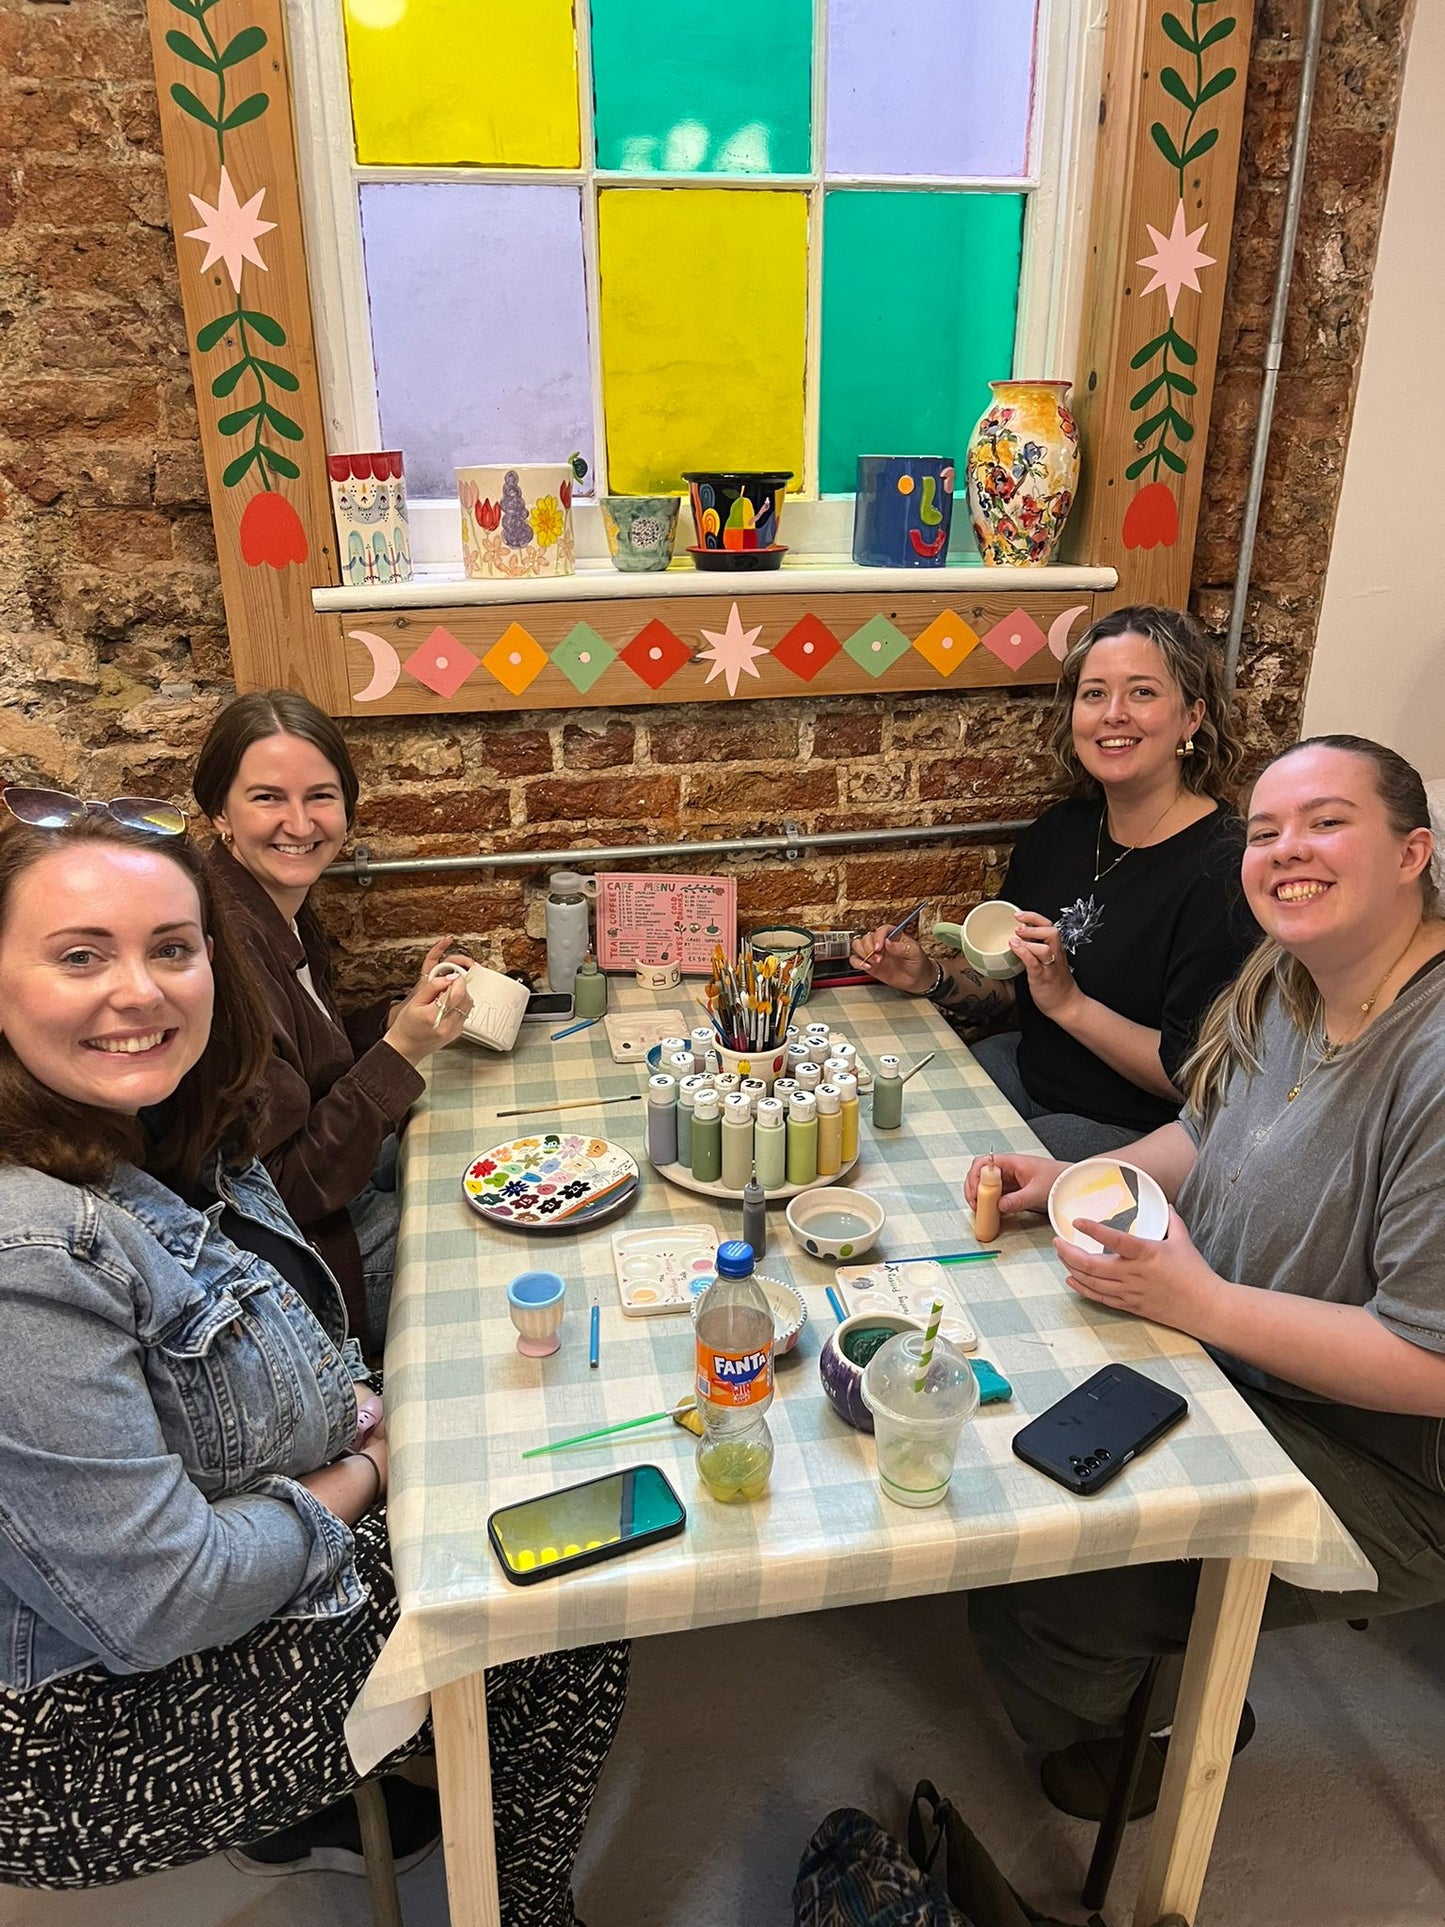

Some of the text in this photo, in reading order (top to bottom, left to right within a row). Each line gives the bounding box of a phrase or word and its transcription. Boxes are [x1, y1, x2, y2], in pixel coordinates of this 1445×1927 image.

[643, 882, 676, 893] MENU
[609, 892, 618, 925] COFFEE
[609, 941, 618, 959] TEA
[777, 1080, 795, 1088] 22
[568, 1185, 584, 1194] 22
[520, 1197, 533, 1206] 15
[714, 1352, 767, 1376] FANTA
